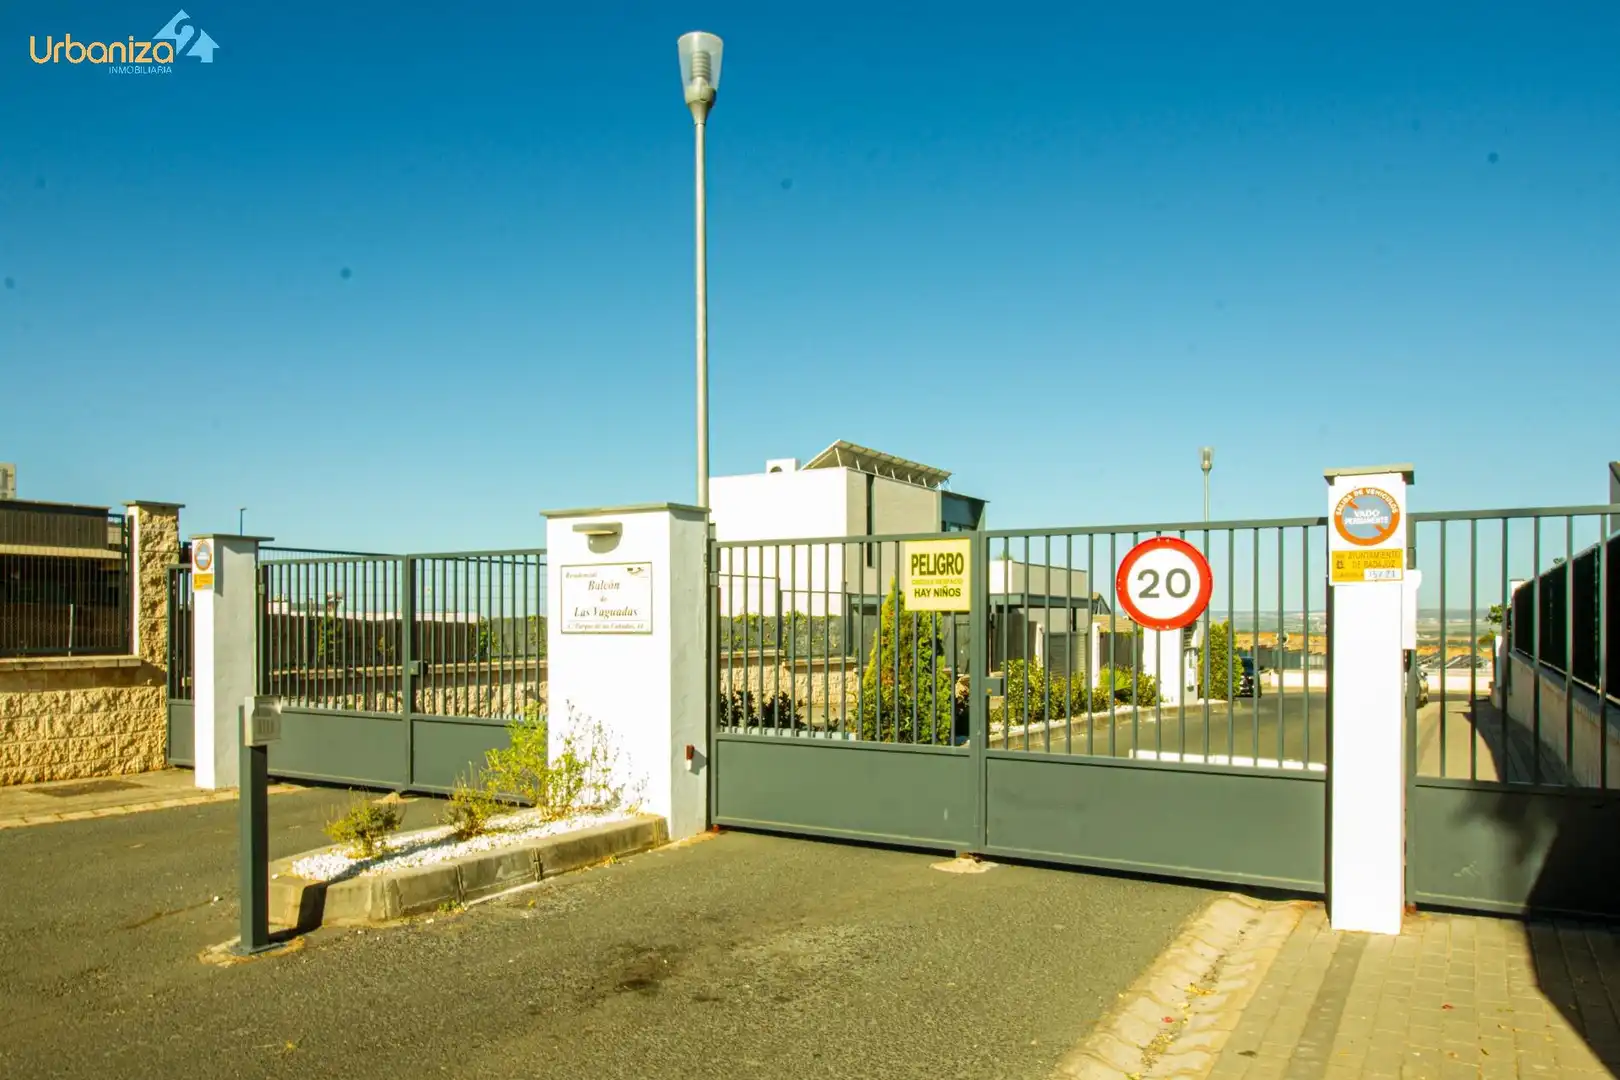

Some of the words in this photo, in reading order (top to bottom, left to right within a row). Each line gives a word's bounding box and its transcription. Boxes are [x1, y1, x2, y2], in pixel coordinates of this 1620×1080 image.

[1353, 509, 1380, 517] VADO
[911, 552, 964, 576] PELIGRO
[588, 580, 620, 591] Balcón
[1137, 568, 1191, 599] 20
[914, 588, 931, 598] HAY
[933, 585, 961, 597] NIÑOS
[574, 607, 590, 617] Las
[593, 606, 638, 619] Vaguadas
